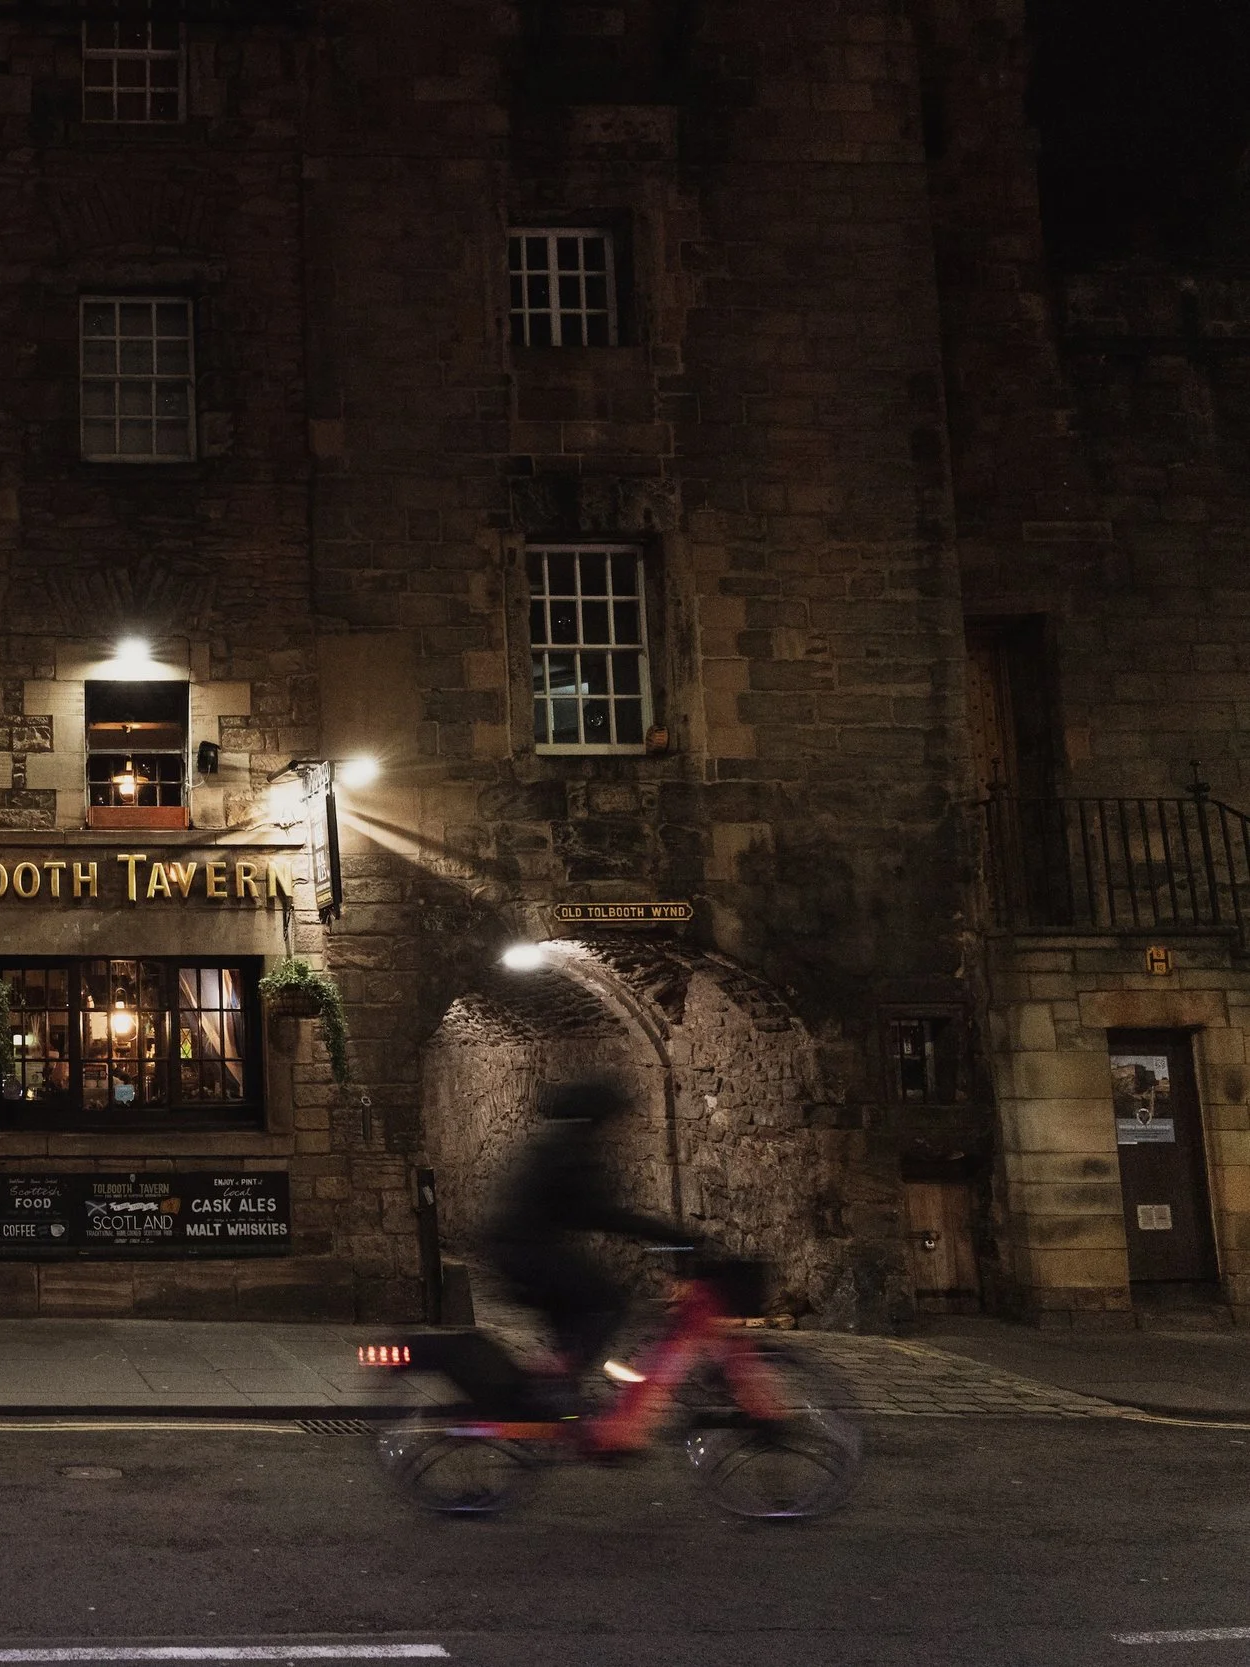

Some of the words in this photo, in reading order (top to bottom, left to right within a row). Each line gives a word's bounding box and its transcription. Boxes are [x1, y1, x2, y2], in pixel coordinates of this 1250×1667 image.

[117, 854, 293, 902] TAVERN
[561, 907, 582, 918] OLD
[587, 907, 645, 918] TOLBOOTH
[651, 906, 685, 917] WYND
[92, 1183, 132, 1194] TOLBOOTH
[139, 1183, 170, 1194] TAVERN
[213, 1178, 235, 1186] ENJOY
[241, 1178, 257, 1186] PINT
[15, 1198, 51, 1209] FOOD
[191, 1198, 232, 1213] CASK
[239, 1197, 277, 1212] ALES
[92, 1215, 173, 1230] SCOTLAND
[3, 1224, 36, 1237] COFFEE
[186, 1223, 222, 1236] MALT
[227, 1223, 288, 1236] WHISKIES
